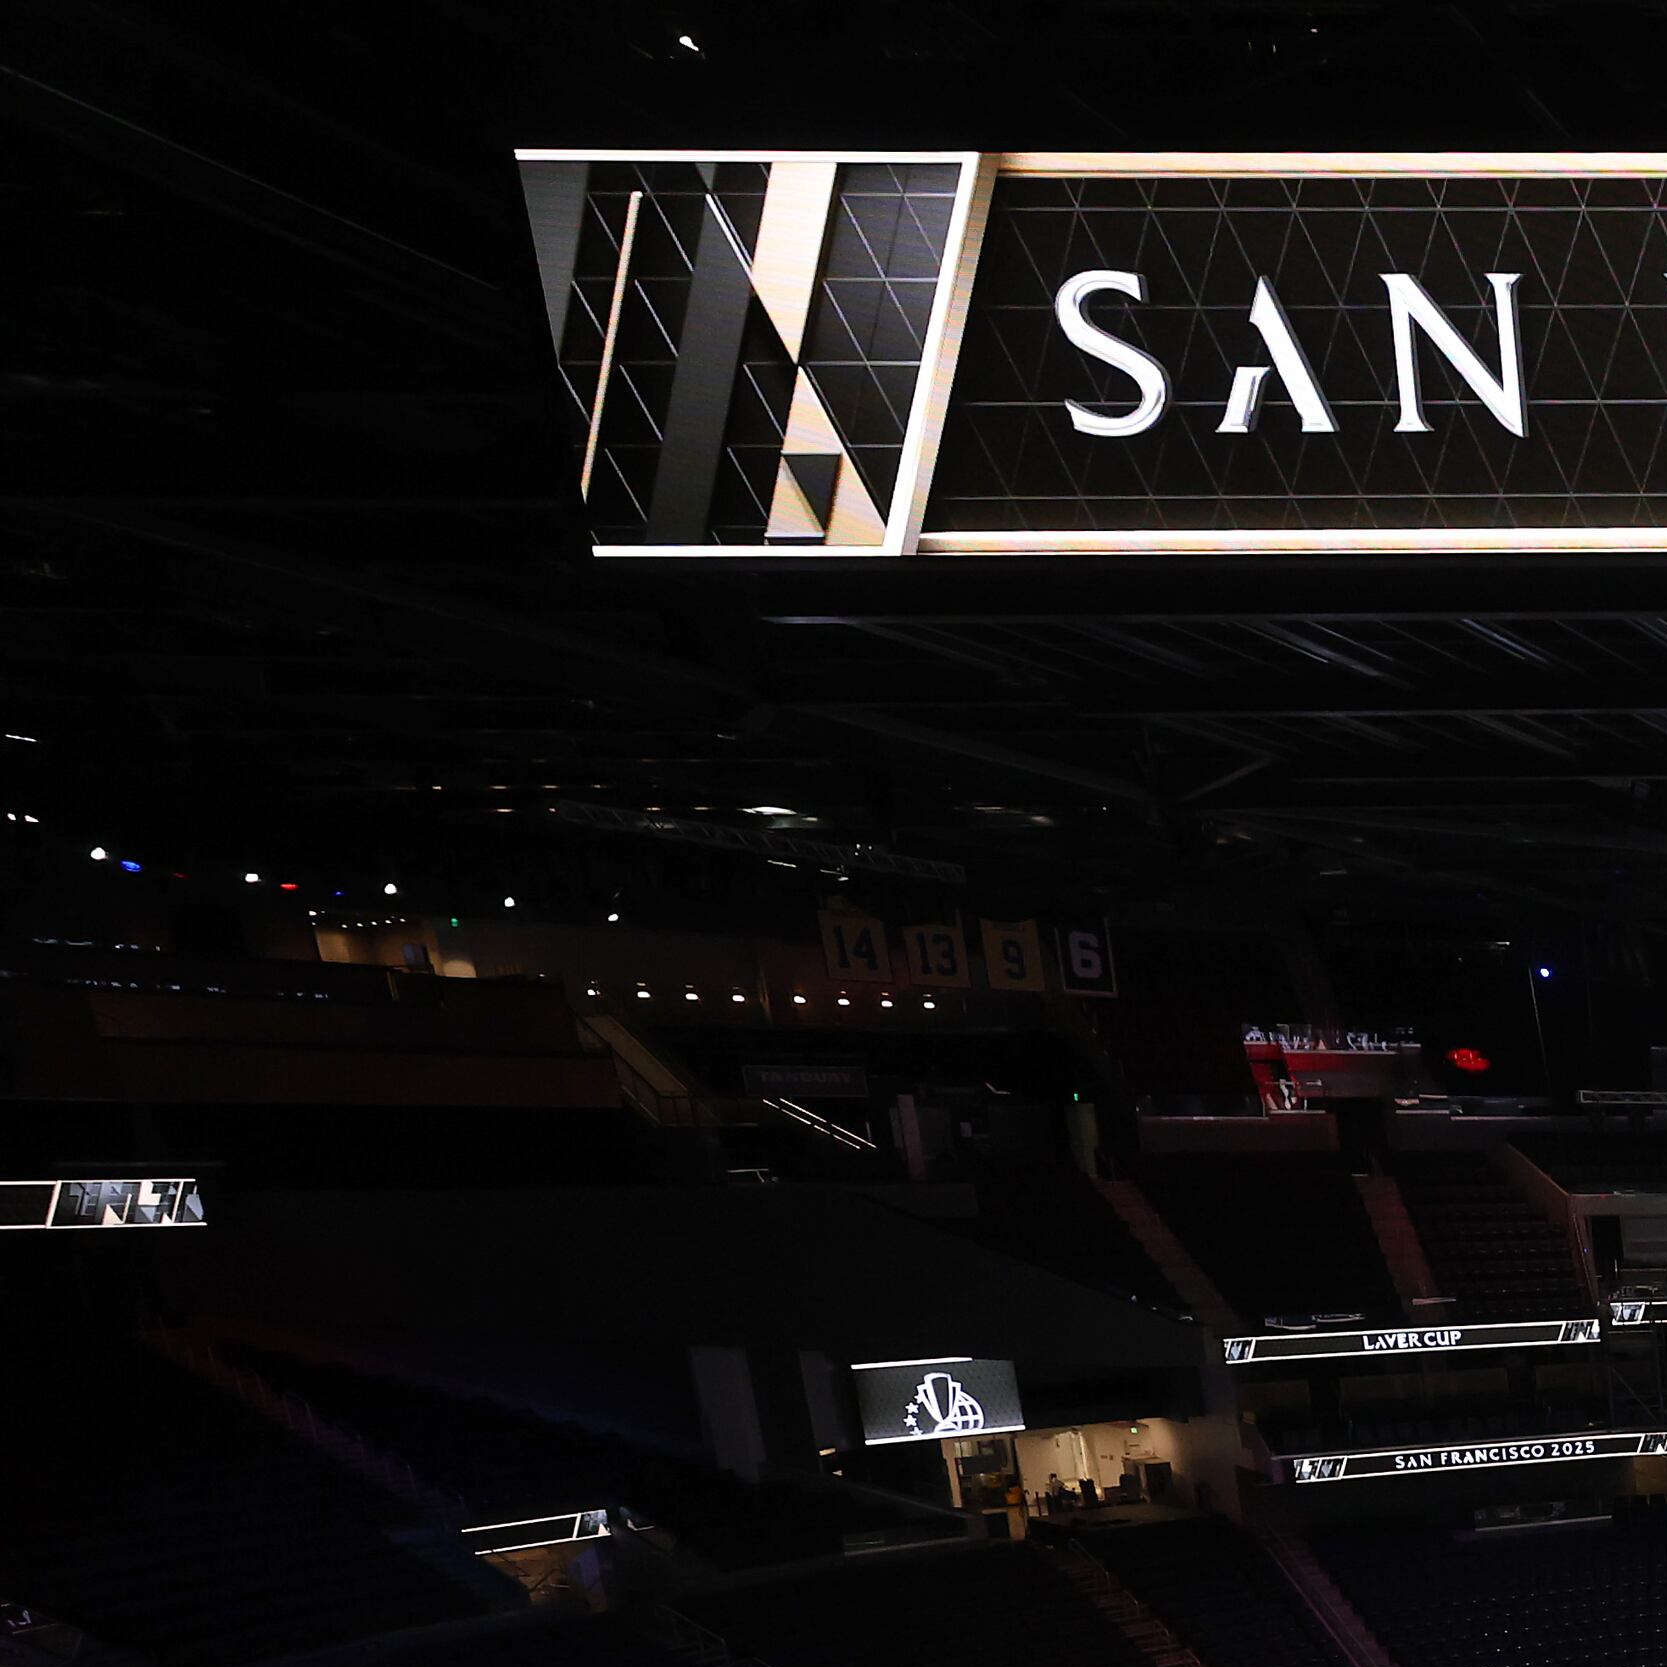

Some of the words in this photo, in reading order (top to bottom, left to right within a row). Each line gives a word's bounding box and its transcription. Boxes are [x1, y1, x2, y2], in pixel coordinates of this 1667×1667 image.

[1054, 269, 1528, 438] SAN
[832, 924, 879, 971] 14
[916, 932, 957, 977] 13
[1002, 938, 1026, 980] 9
[1067, 929, 1103, 980] 6
[1363, 1333, 1425, 1351] LAVER
[1425, 1330, 1462, 1347] CUP
[1395, 1454, 1434, 1470] SAN
[1440, 1443, 1545, 1465] FRANCISCO
[1550, 1439, 1596, 1456] 2025
